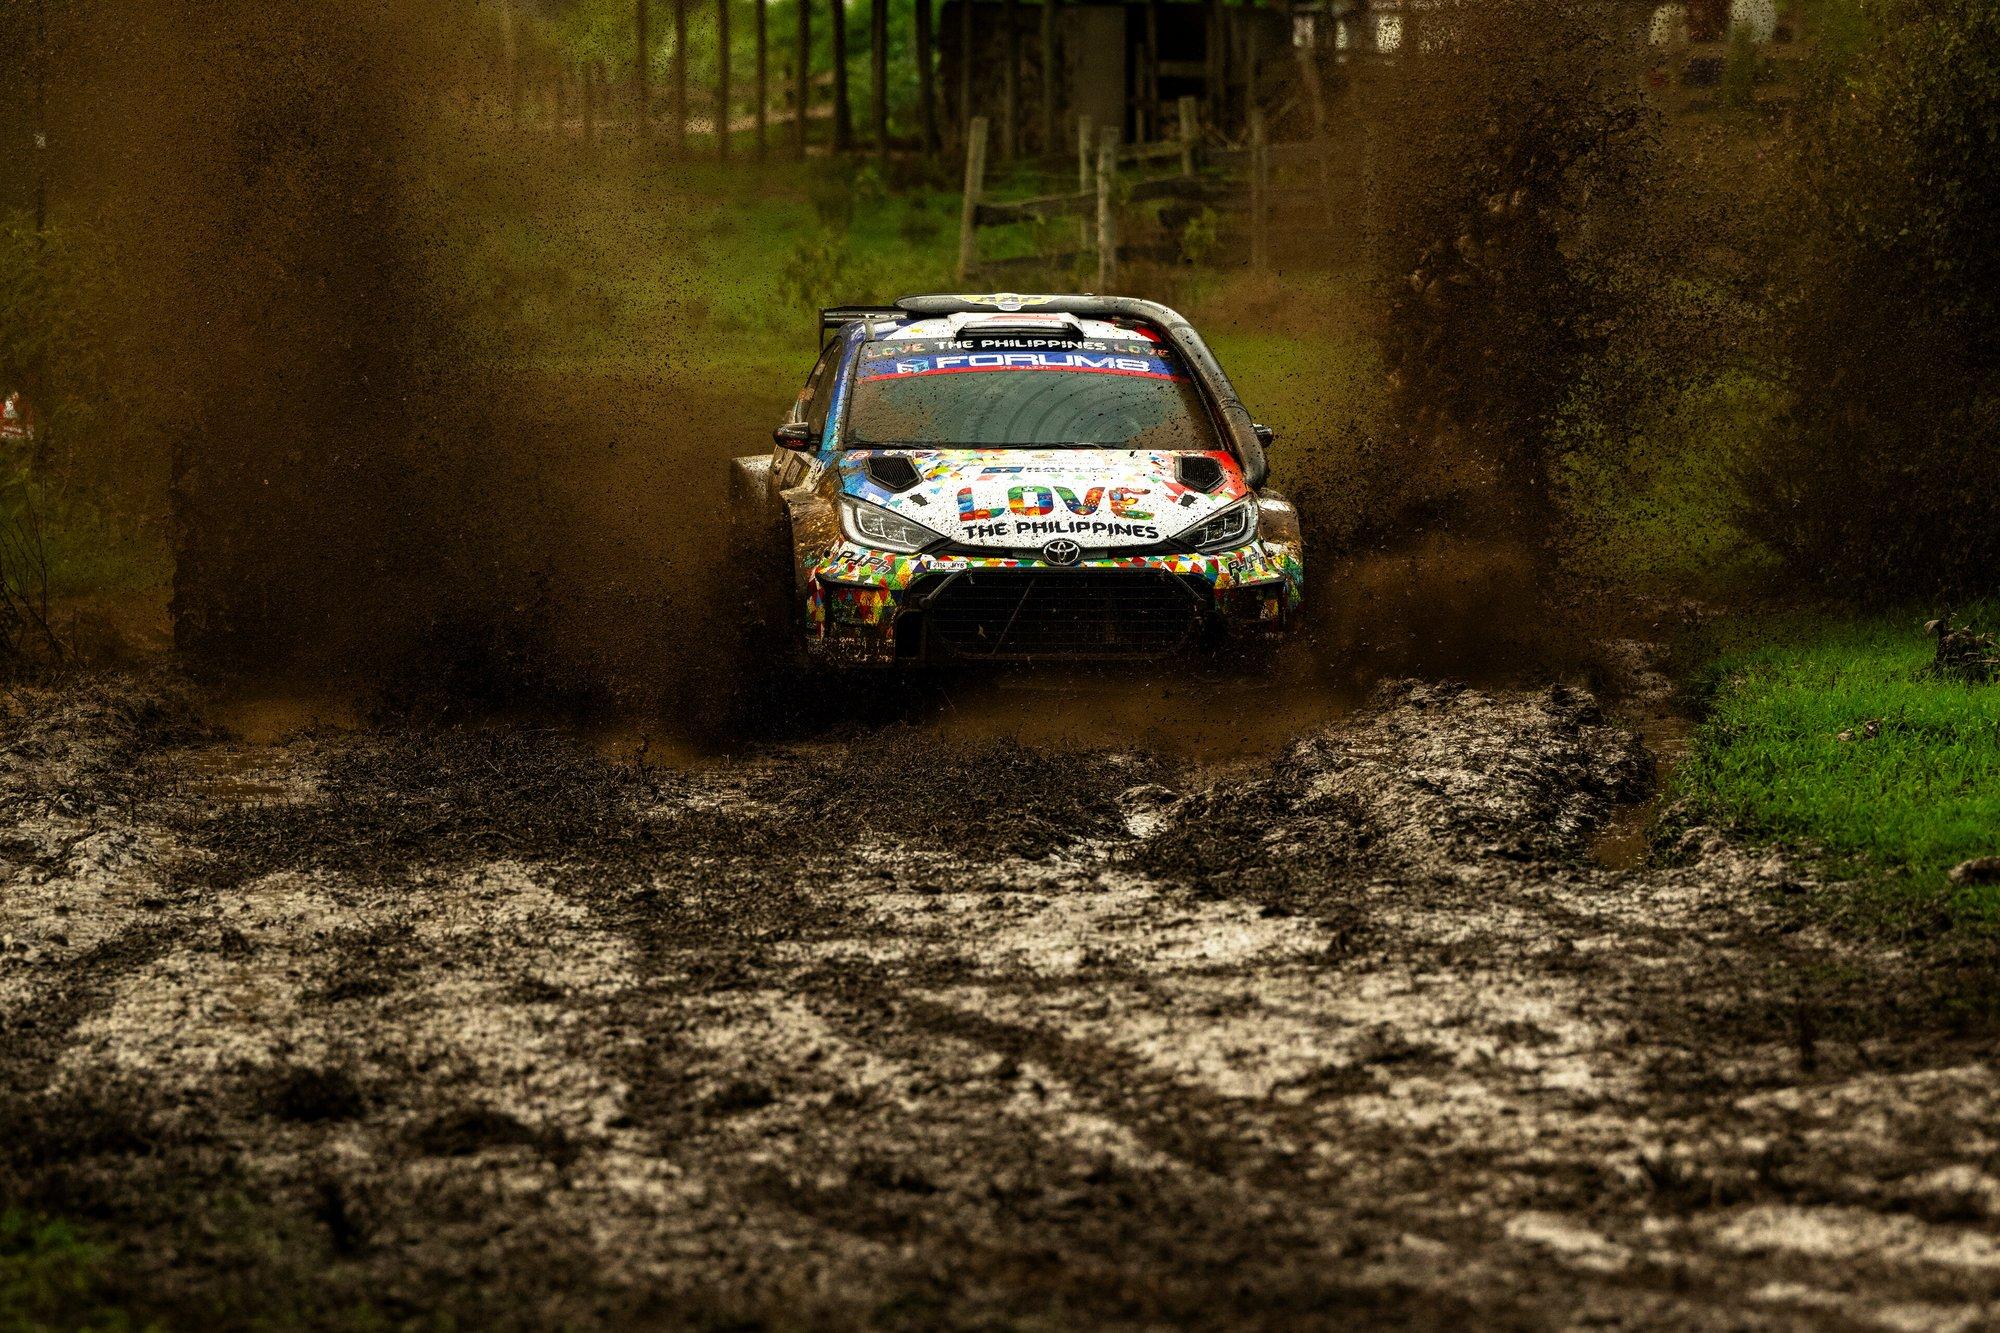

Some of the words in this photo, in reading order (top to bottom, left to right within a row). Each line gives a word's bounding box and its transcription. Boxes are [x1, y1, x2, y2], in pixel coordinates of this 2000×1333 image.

[867, 342, 926, 359] LOVE
[935, 340, 974, 350] THE
[981, 339, 1107, 351] PHILIPPINES
[936, 353, 1151, 372] FORUM8
[956, 486, 1155, 522] LOVE
[962, 522, 1008, 540] THE
[1016, 521, 1160, 539] PHILIPPINES
